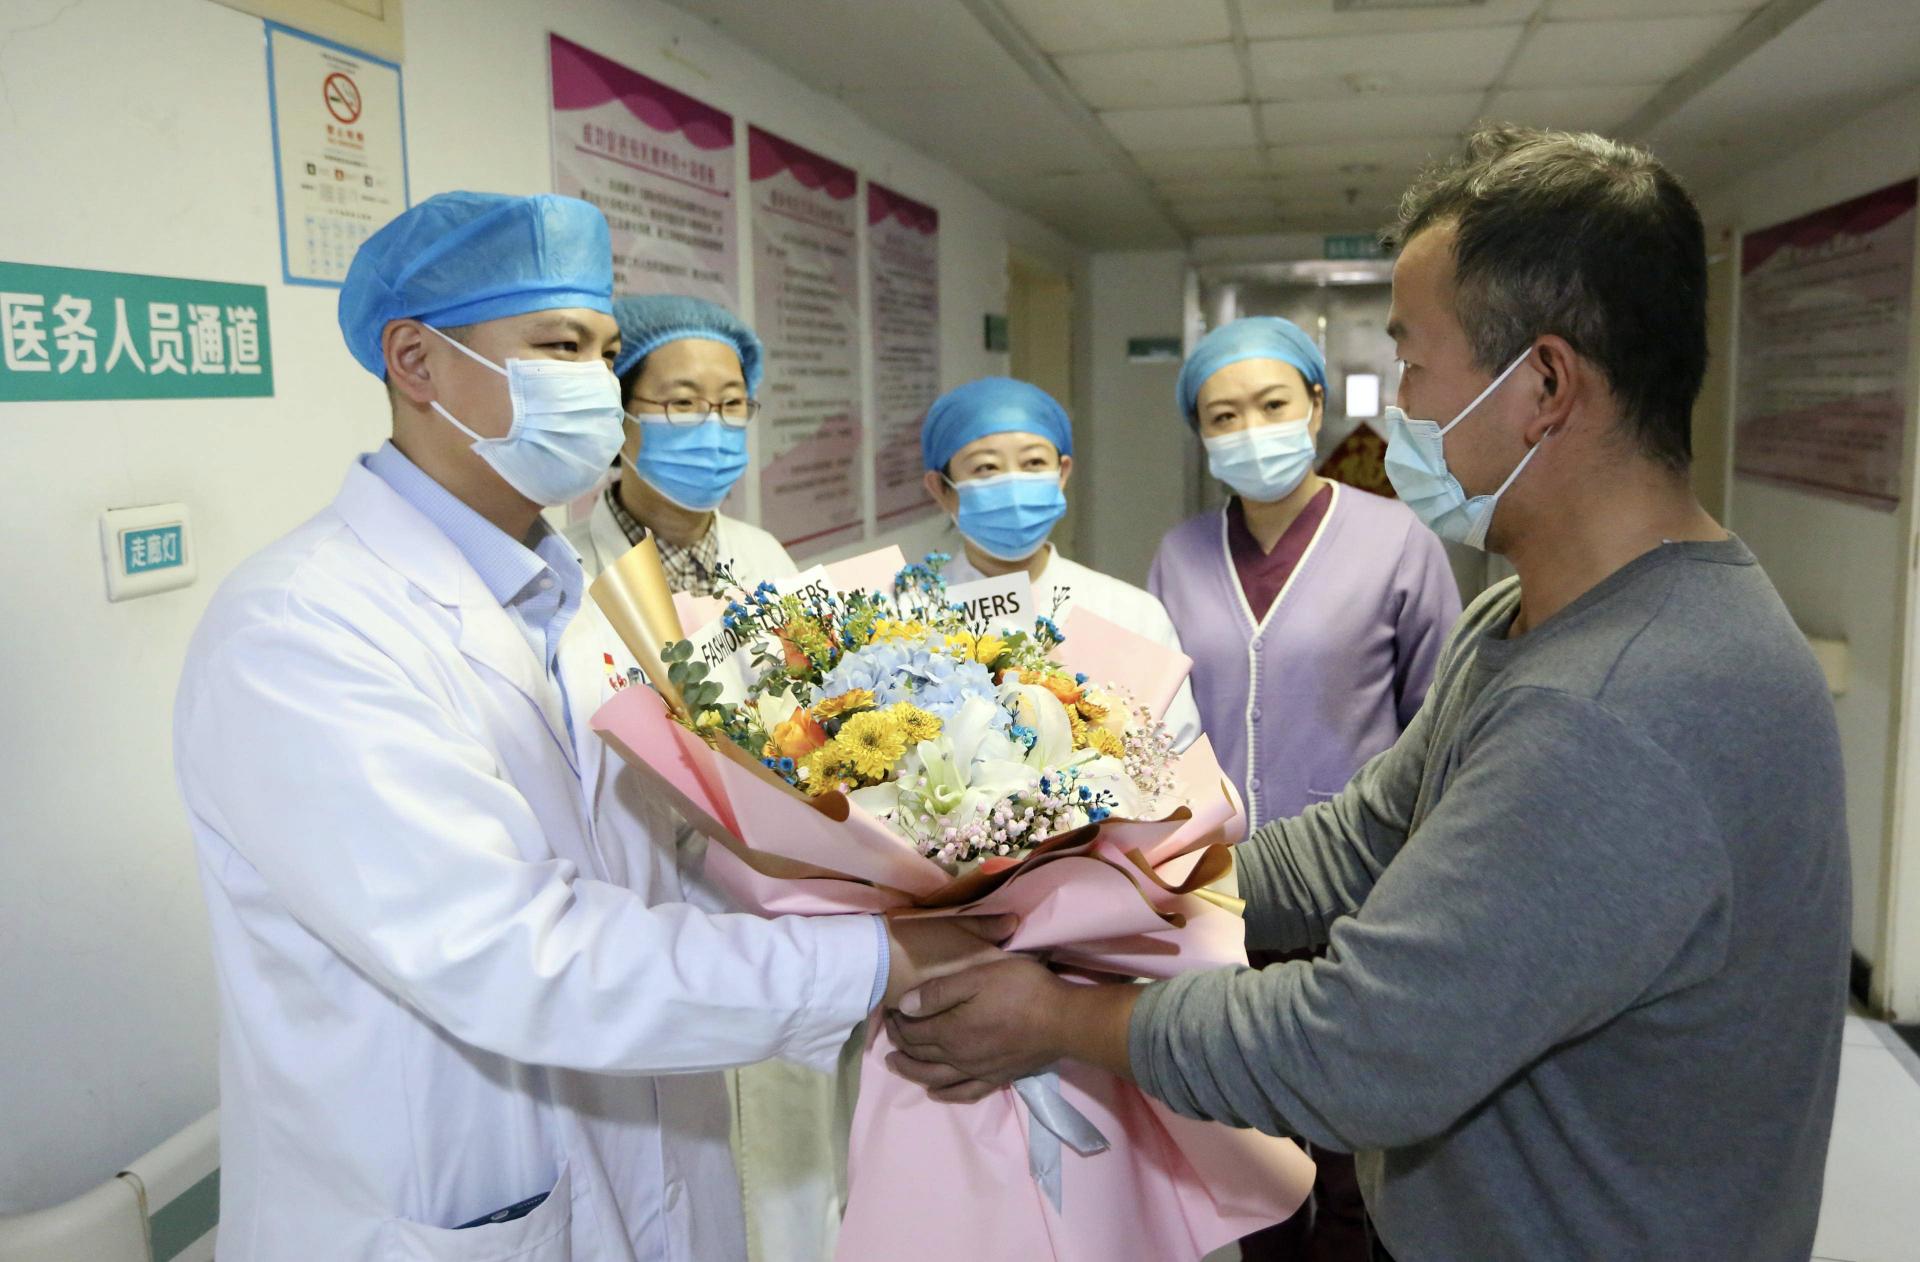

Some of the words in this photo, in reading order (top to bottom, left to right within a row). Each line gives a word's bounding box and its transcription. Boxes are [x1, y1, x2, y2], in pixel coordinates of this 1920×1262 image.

[0, 291, 262, 375] 医务人员通道
[130, 532, 177, 568] 走廊灯
